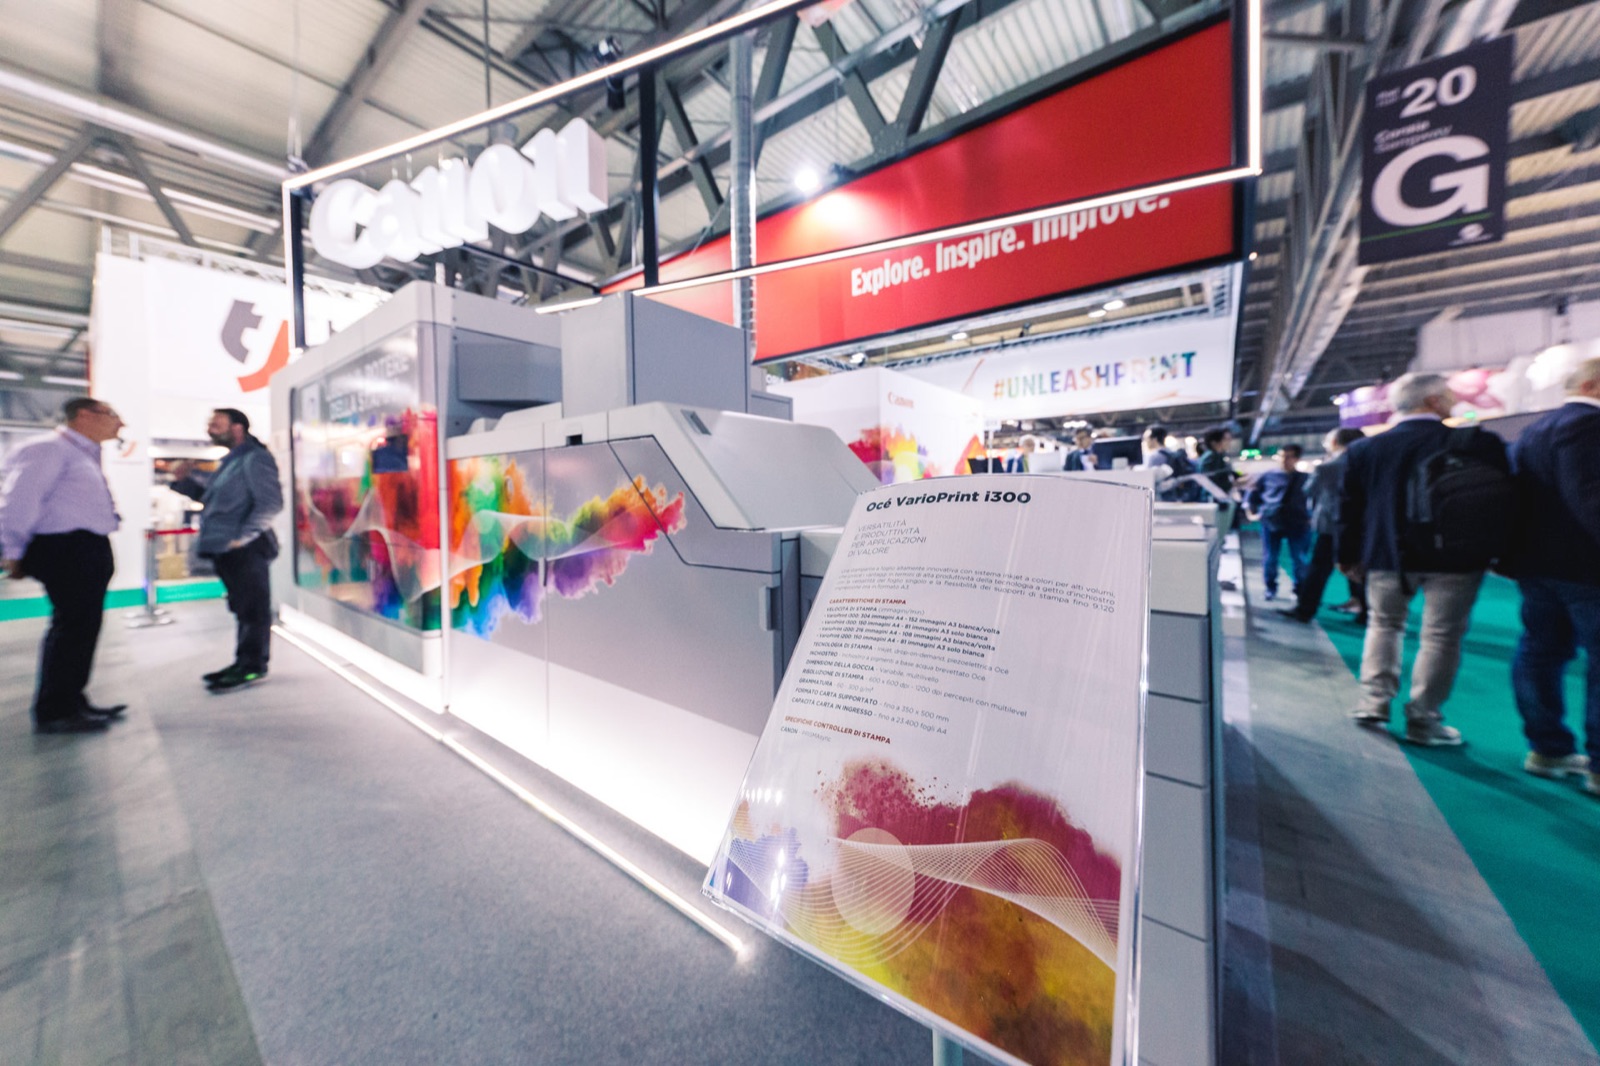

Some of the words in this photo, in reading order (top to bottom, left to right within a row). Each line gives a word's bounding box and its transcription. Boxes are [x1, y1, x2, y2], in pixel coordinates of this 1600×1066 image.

[1400, 65, 1477, 118] 20
[1372, 135, 1490, 226] G
[852, 255, 930, 296] Explore.
[936, 227, 1024, 273] Inspire.
[866, 498, 892, 512] Océ
[897, 491, 979, 506] VarioPrint
[984, 491, 1031, 504] i300
[858, 520, 906, 532] VERSATILITÀ
[860, 527, 920, 540] PRODUTTIVITÀ
[851, 540, 866, 548] PER
[868, 536, 926, 546] APPLICAZIONI
[857, 546, 889, 556] VALORE
[935, 573, 972, 582] produttività
[976, 576, 992, 584] della
[994, 578, 1033, 591] tecnologia
[1042, 585, 1064, 596] getto
[1066, 590, 1114, 605] d'inchiostro
[974, 569, 1000, 578] sistema
[1002, 572, 1022, 582] inkjet
[1031, 576, 1052, 586] colori
[1056, 581, 1068, 589] per
[1071, 583, 1083, 591] alti
[1086, 585, 1116, 599] volumi,
[994, 585, 1025, 597] supporti
[1040, 592, 1069, 605] stampa
[1073, 599, 1088, 608] fino
[1093, 603, 1114, 613] 9.120
[868, 620, 891, 628] immagini
[912, 624, 940, 634] immagini
[951, 629, 964, 637] solo
[966, 631, 988, 641] bianca
[872, 613, 894, 621] immagini
[920, 617, 946, 627] immagini
[958, 622, 1000, 636] bianca/volta
[863, 634, 886, 643] immagini
[908, 639, 936, 650] immagini
[947, 645, 960, 654] solo
[962, 648, 984, 658] bianca
[865, 627, 888, 636] immagini
[914, 632, 941, 642] immagini
[953, 637, 996, 652] bianca/volta
[852, 663, 874, 671] GOCCIA
[900, 659, 914, 667] base
[916, 663, 934, 672] acqua
[935, 666, 970, 678] brevettato
[972, 672, 986, 681] Océ
[994, 665, 1008, 675] Océ
[795, 686, 818, 695] FORMATO
[820, 690, 836, 698] CARTA
[838, 693, 878, 705] SUPPORTATO
[883, 701, 895, 710] fino
[902, 706, 914, 714] 350
[920, 710, 934, 718] 500
[842, 671, 864, 680] STAMPA
[886, 678, 898, 687] 600
[900, 681, 910, 690] dpi
[916, 684, 930, 693] 1200
[932, 688, 942, 697] dpi
[944, 690, 974, 705] percepiti
[976, 699, 988, 707] con
[990, 702, 1027, 717] multilevel
[816, 699, 834, 708] CARTA
[842, 704, 872, 717] INGRESSO
[920, 723, 935, 733] fogli
[780, 725, 798, 734] CANON
[814, 720, 852, 734] CONTROLLER
[862, 731, 890, 743] STAMPA
